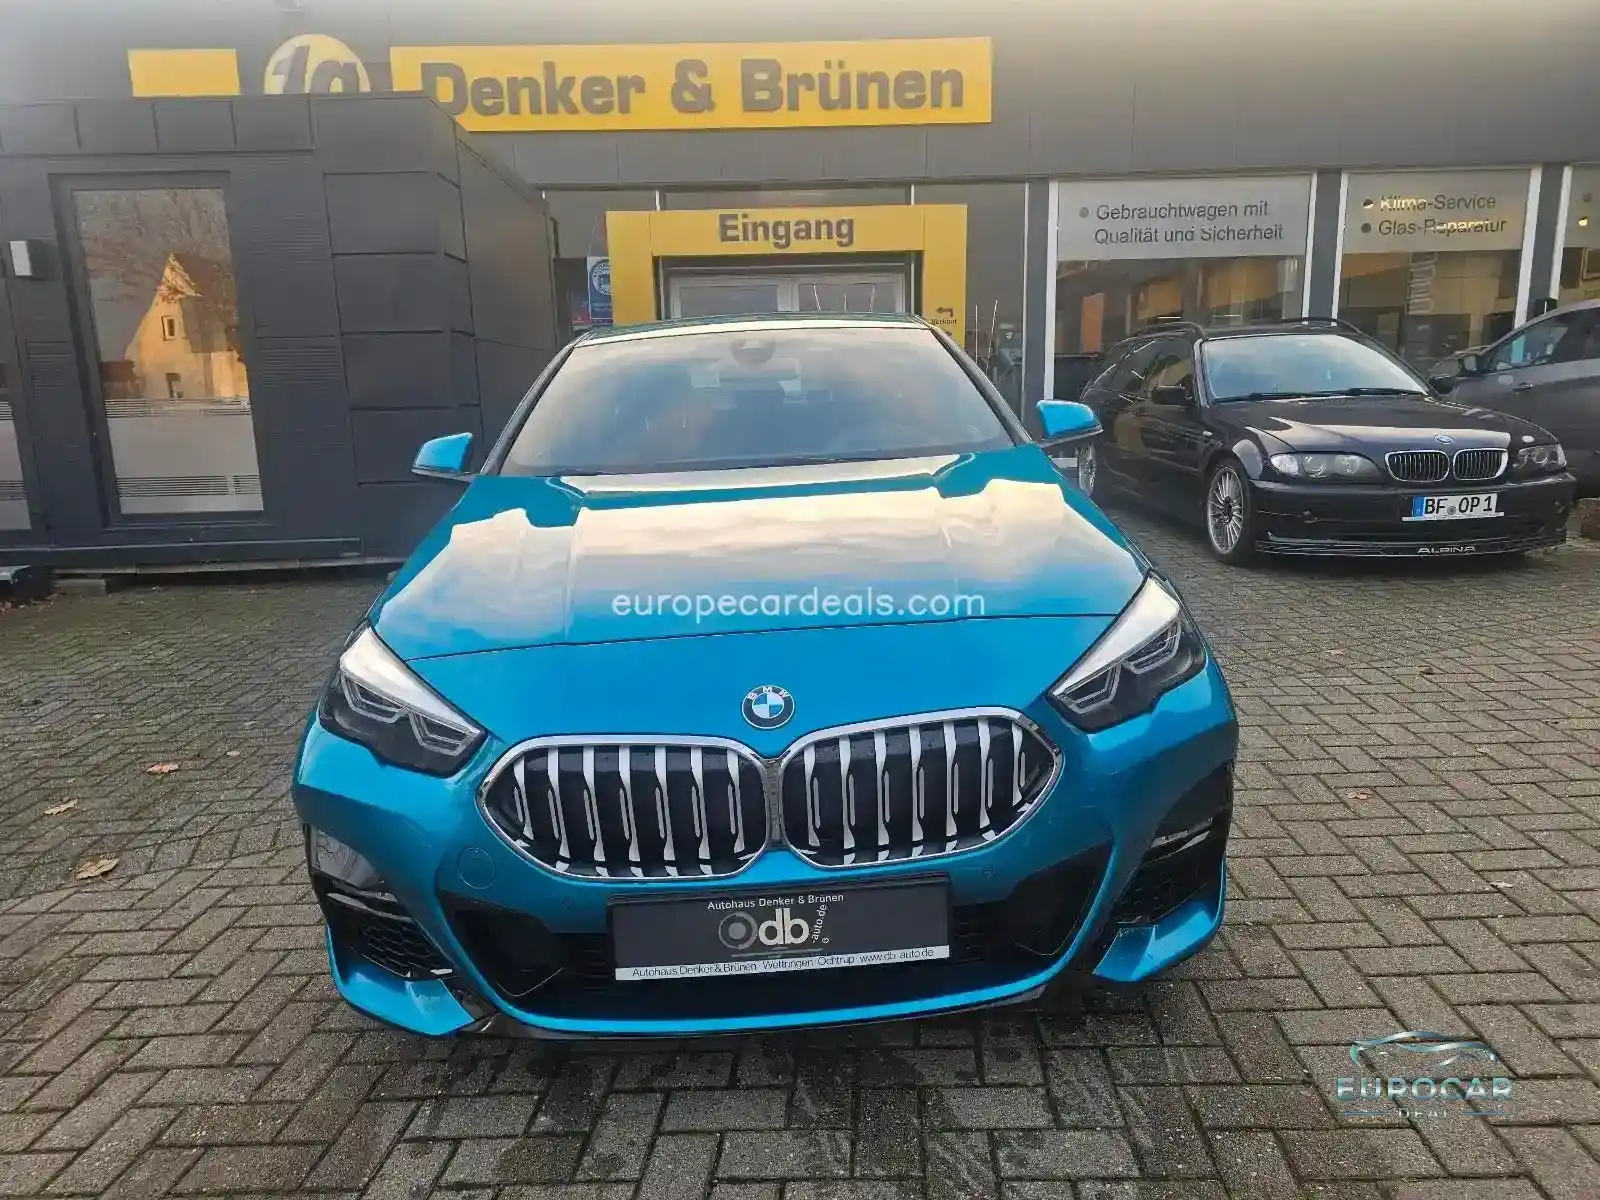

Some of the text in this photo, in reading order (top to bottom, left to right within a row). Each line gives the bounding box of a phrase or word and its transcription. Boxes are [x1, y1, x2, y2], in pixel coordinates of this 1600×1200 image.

[421, 58, 965, 116] Denker & Brünen
[1096, 200, 1269, 221] Gebrauchtwagen mit
[1380, 193, 1497, 212] Klima-Service
[718, 213, 854, 249] Eingang
[1094, 223, 1284, 245] Qualität und Sicherheit
[1378, 218, 1507, 237] Glas-Reparatur
[1424, 498, 1448, 515] BF
[747, 686, 790, 700] BMW
[707, 900, 756, 911] Autohaus
[758, 896, 794, 907] Denker
[632, 967, 678, 978] Autohaus
[680, 964, 714, 975] Denker
